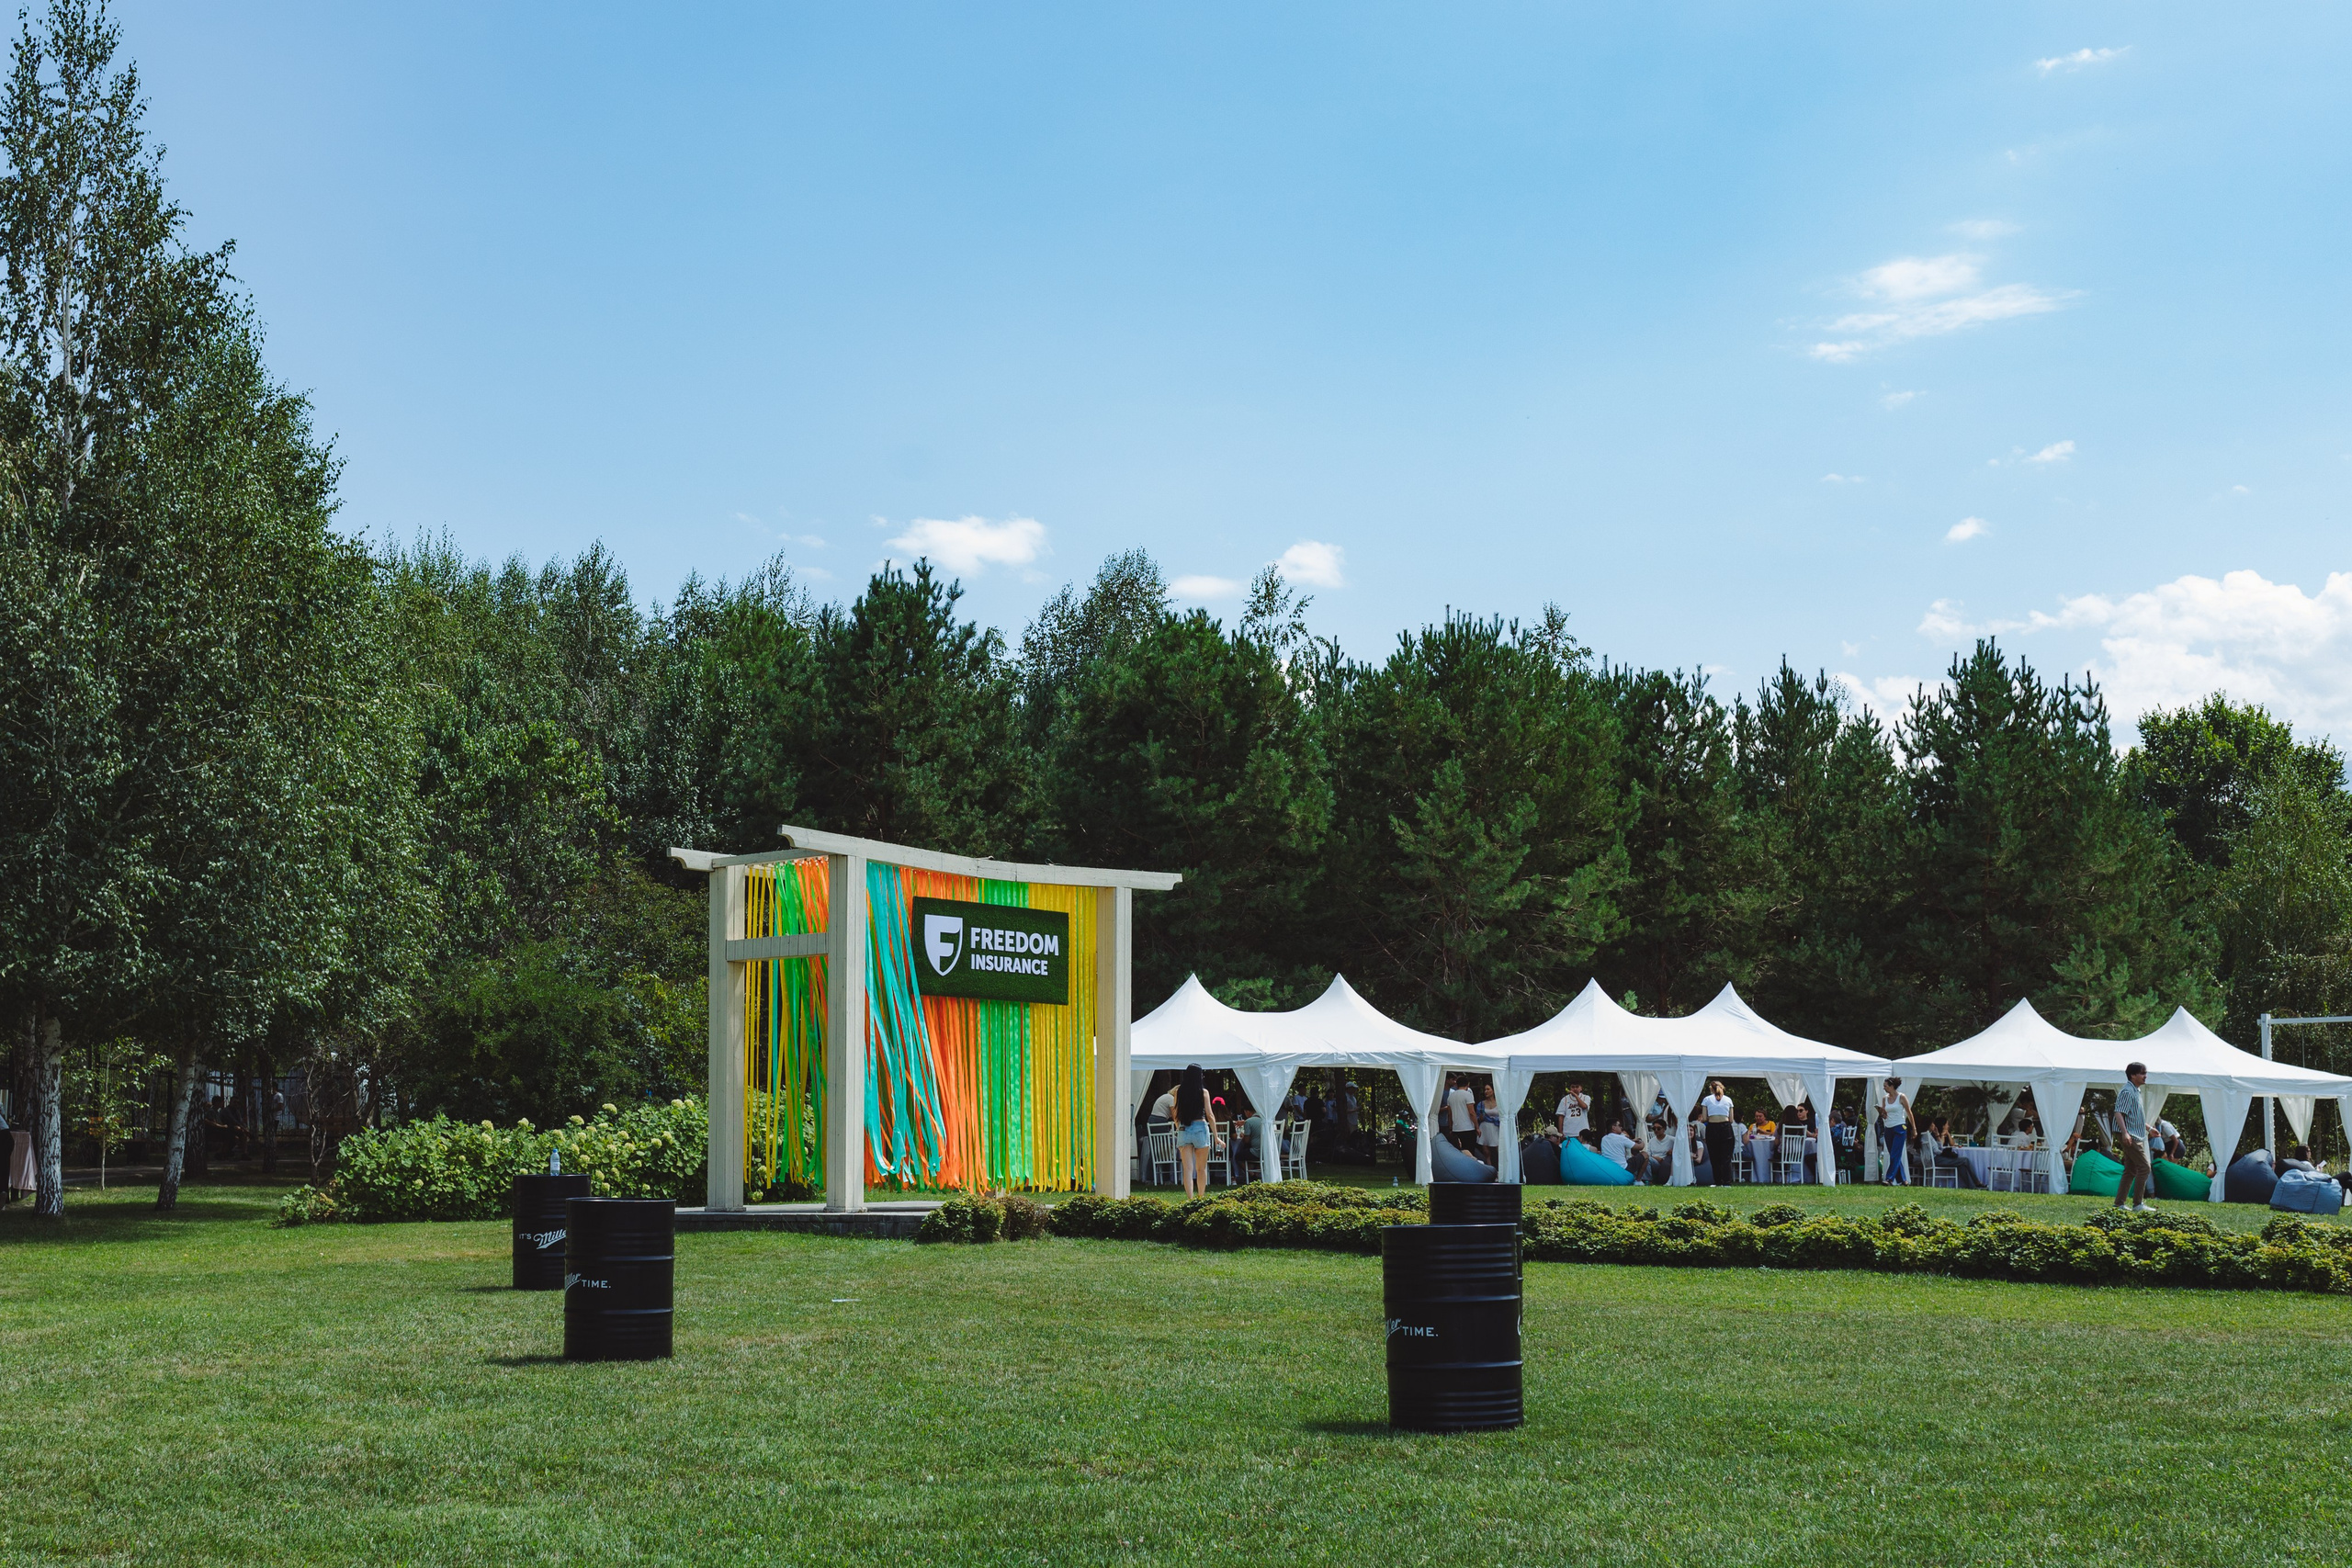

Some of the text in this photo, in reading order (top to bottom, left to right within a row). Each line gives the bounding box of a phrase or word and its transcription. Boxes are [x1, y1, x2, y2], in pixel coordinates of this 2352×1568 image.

[970, 927, 1059, 956] FREEDOM
[970, 953, 1048, 976] INSURANCE
[1570, 1108, 1581, 1118] 23
[533, 1228, 567, 1250] Mille
[581, 1279, 612, 1289] TIME.
[1402, 1325, 1439, 1337] TIME.
